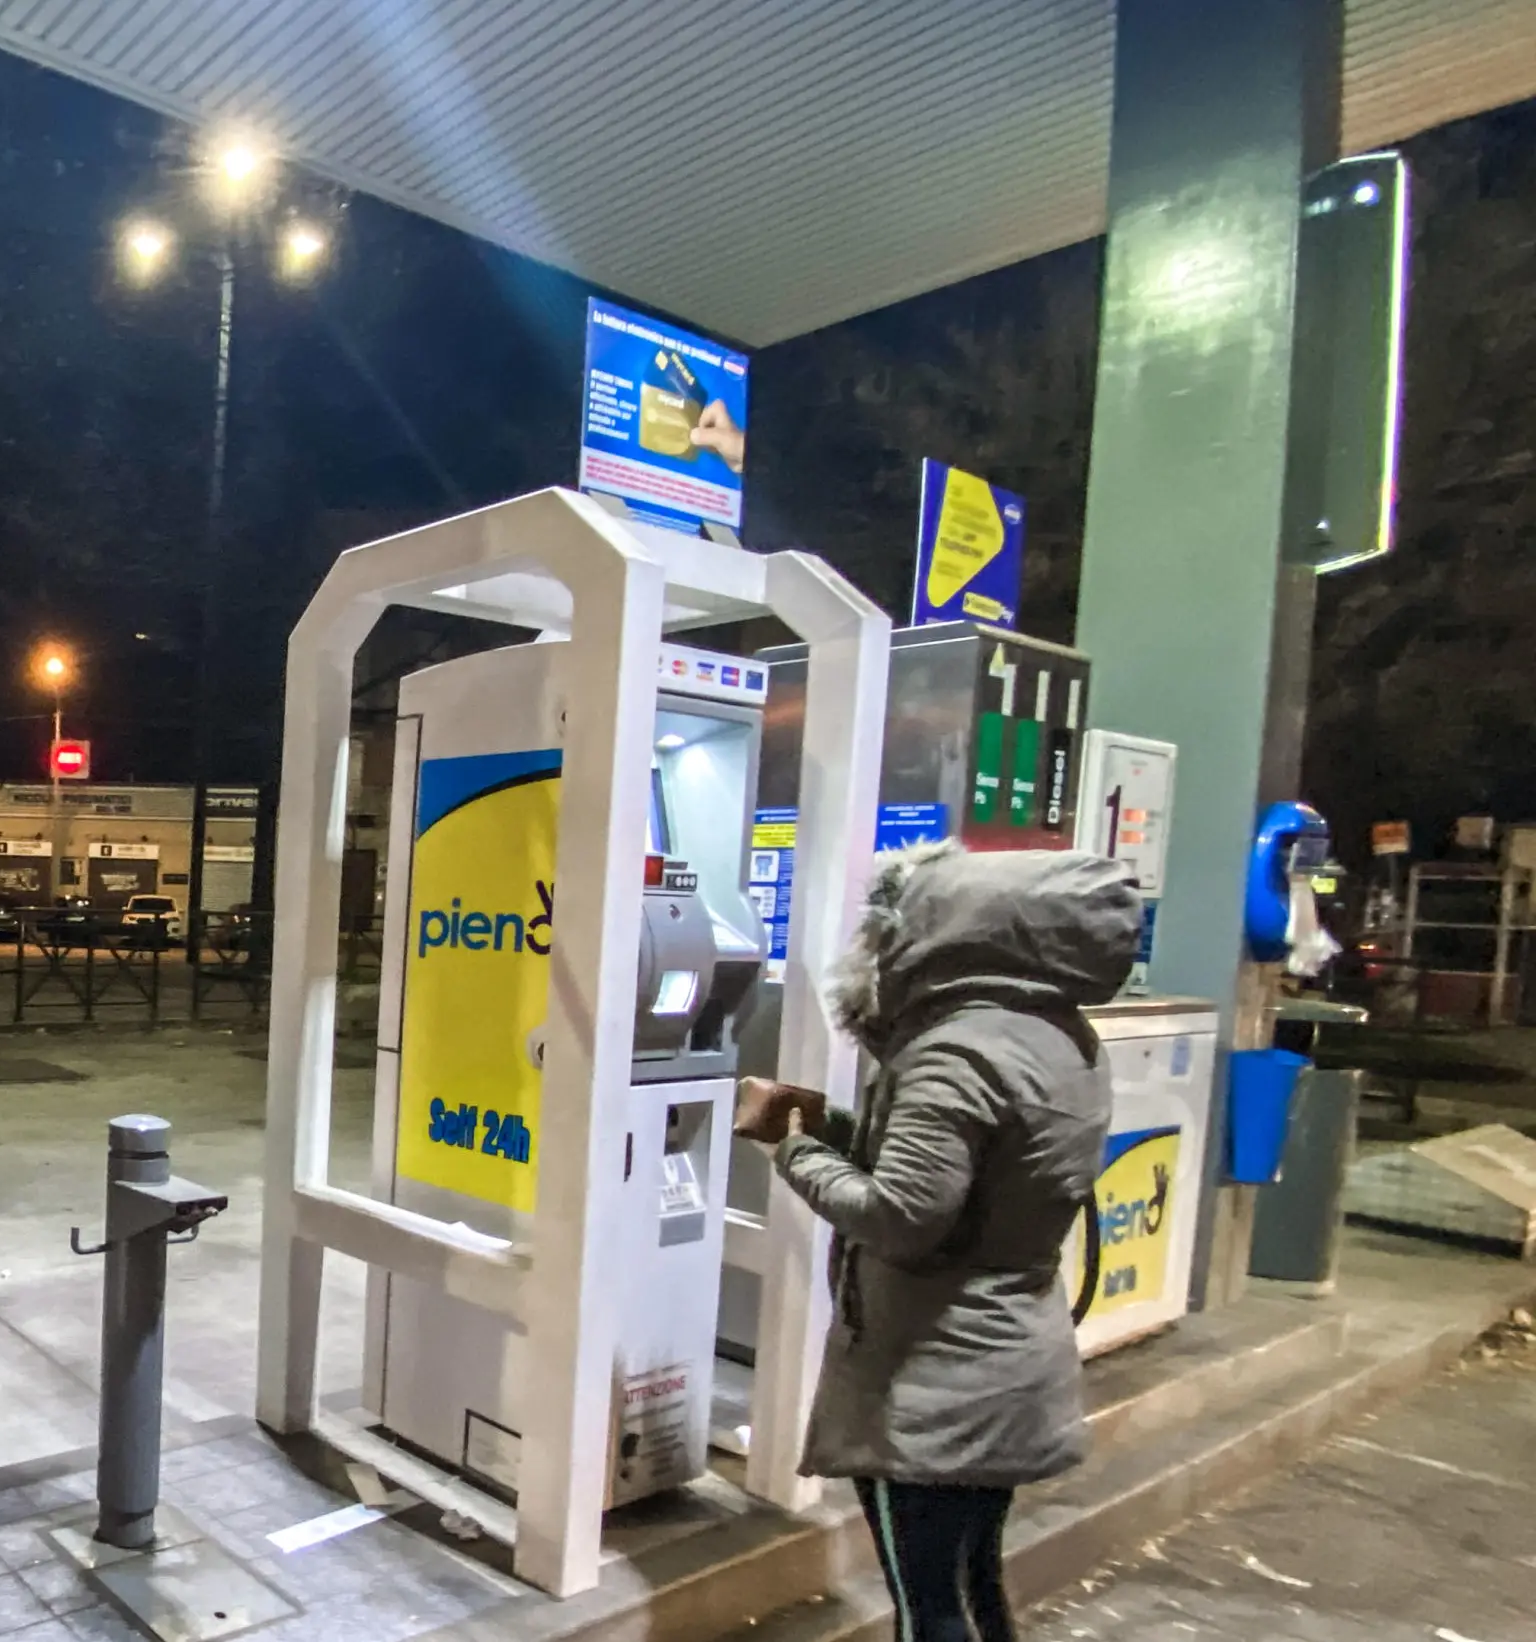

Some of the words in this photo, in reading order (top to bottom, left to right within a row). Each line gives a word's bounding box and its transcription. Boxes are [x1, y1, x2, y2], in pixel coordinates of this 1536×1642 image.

[1047, 750, 1067, 824] Diesel
[1105, 784, 1122, 859] 1
[428, 1096, 478, 1151] Self
[481, 1108, 531, 1165] 24h
[1098, 1162, 1170, 1245] ieno
